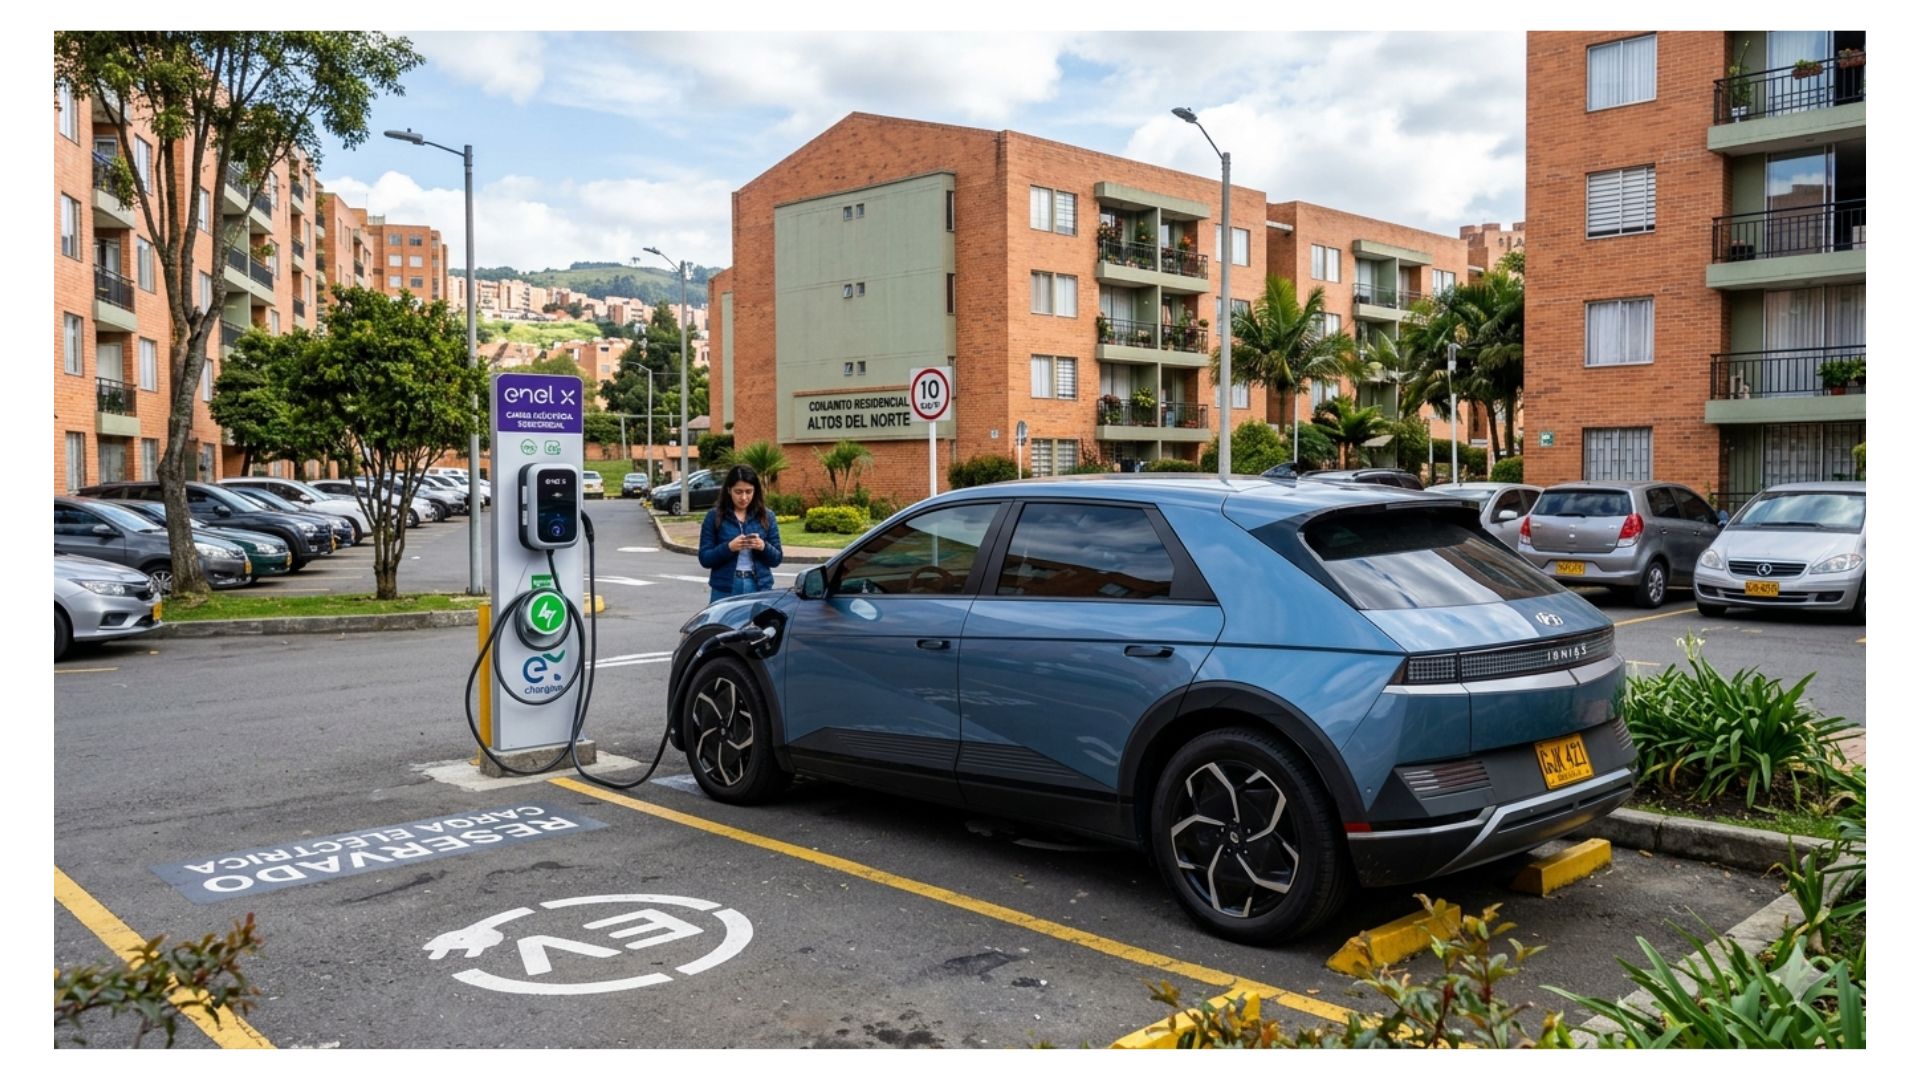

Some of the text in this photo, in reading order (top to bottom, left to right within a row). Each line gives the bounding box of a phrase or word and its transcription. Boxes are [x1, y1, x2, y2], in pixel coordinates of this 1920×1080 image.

[504, 385, 555, 404] enel
[921, 380, 940, 400] 10
[807, 412, 911, 430] ALTOS DEL NORTE
[203, 816, 580, 893] RESERVADO
[517, 908, 704, 976] EV
